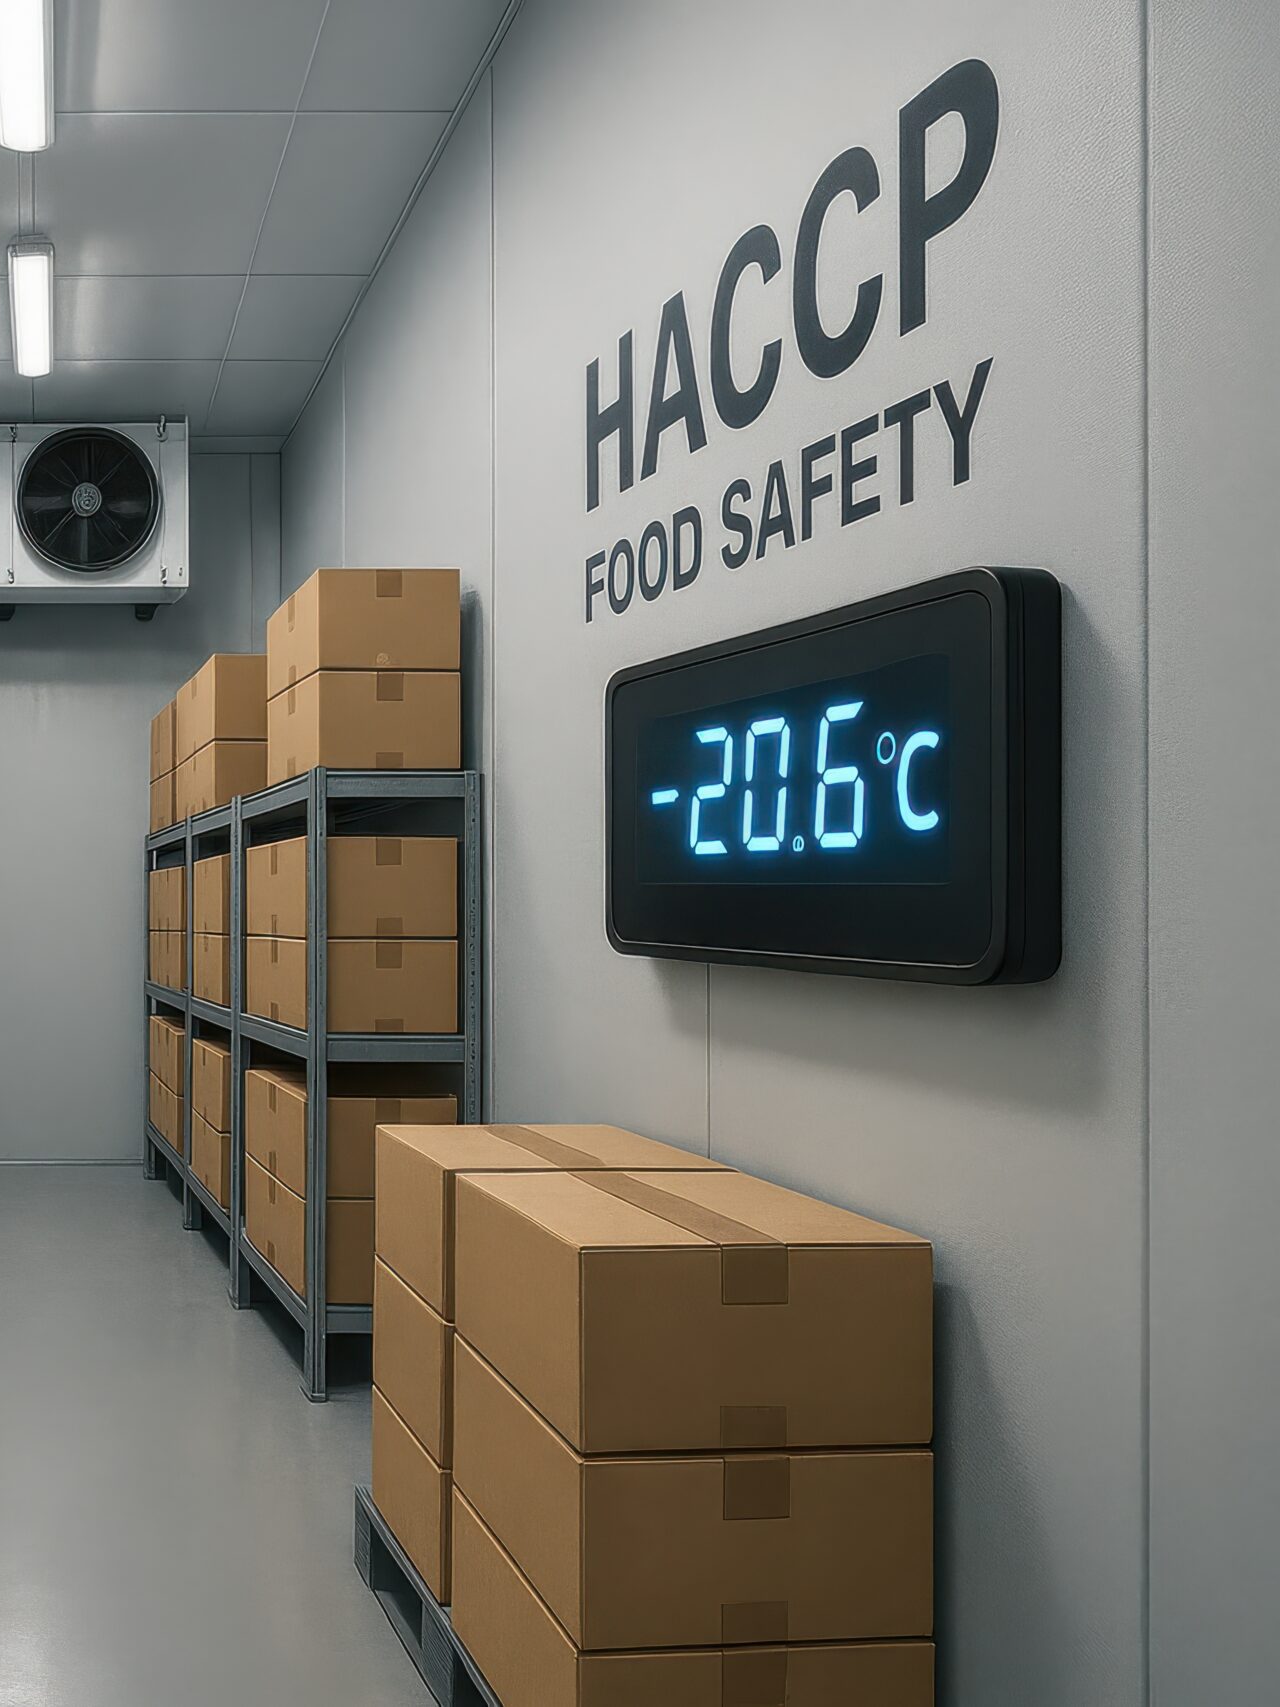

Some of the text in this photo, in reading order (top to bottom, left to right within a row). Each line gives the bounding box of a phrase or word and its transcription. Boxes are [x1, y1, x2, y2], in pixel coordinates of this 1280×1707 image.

[586, 58, 1000, 513] HACCP
[585, 356, 994, 624] FOOD SAFETY
